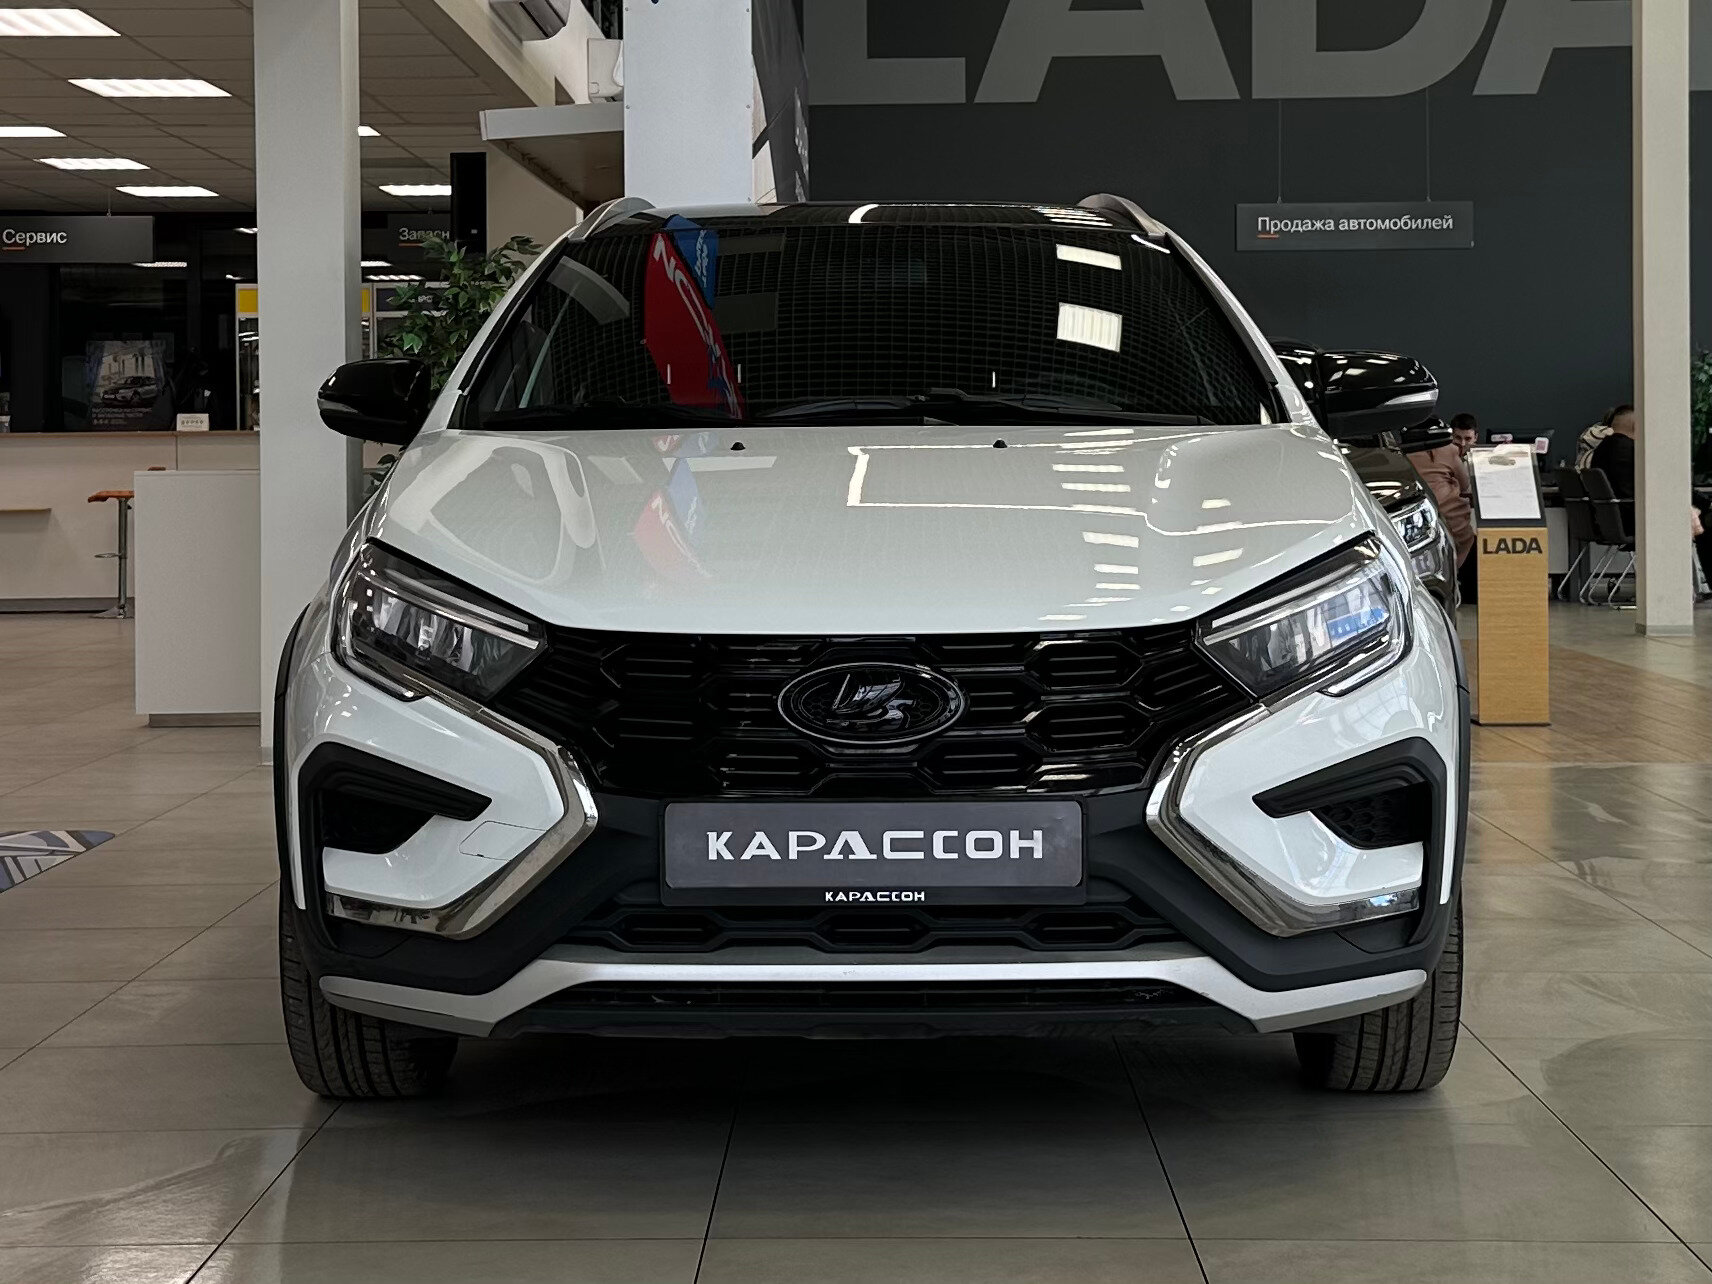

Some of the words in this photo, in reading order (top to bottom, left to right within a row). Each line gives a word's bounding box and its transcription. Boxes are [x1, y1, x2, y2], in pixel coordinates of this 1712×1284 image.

[1257, 216, 1335, 234] Продажа
[1338, 213, 1454, 232] автомобилей
[2, 228, 68, 247] Сервис
[1482, 537, 1543, 555] LADA
[706, 829, 1043, 861] КАРАССОН
[825, 890, 926, 903] КАРАССОН
